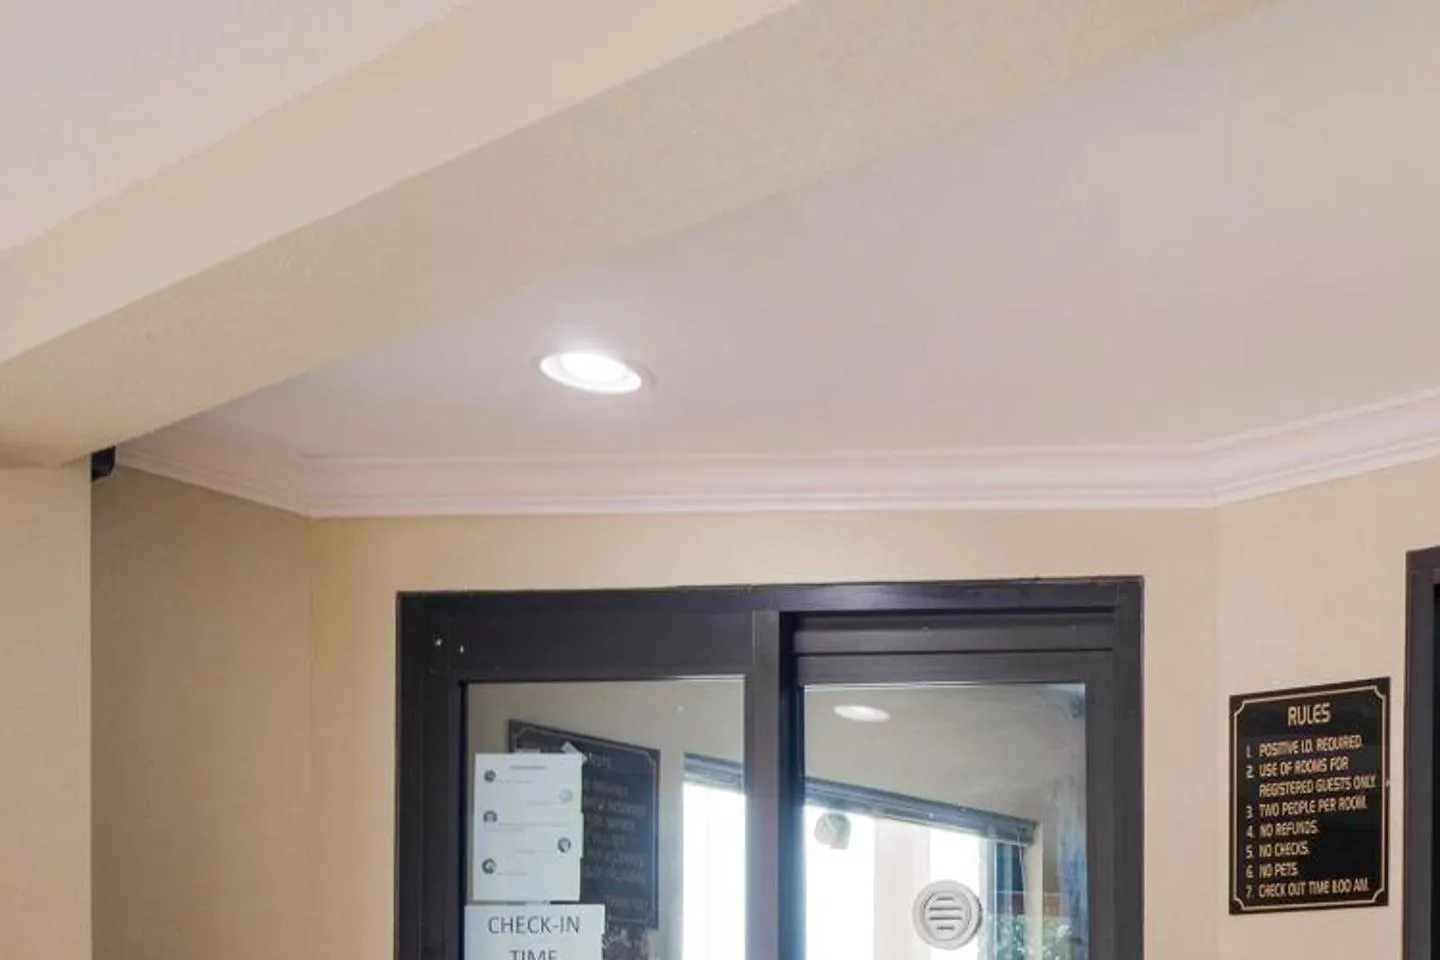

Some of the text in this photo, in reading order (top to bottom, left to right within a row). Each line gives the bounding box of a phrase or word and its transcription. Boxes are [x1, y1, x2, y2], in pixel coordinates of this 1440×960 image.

[1287, 702, 1332, 727] RULES
[1259, 741, 1299, 757] POSITIVE
[1259, 762, 1278, 777] USE
[1280, 761, 1294, 776] OF
[1294, 757, 1328, 775] ROOMS
[1330, 755, 1349, 772] FOR
[1259, 779, 1314, 798] REGISTERED
[1315, 776, 1352, 793] GUESTS
[1259, 803, 1280, 817] TWO
[1281, 800, 1316, 816] PEOPLE
[1317, 798, 1336, 813] PER
[1260, 823, 1273, 838] NO
[1259, 843, 1272, 858] NO
[1259, 864, 1273, 878] NO
[1259, 883, 1286, 898] CHECK
[1288, 881, 1306, 896] OUT
[1308, 880, 1330, 896] TIME
[488, 915, 581, 935] CHECK-IN
